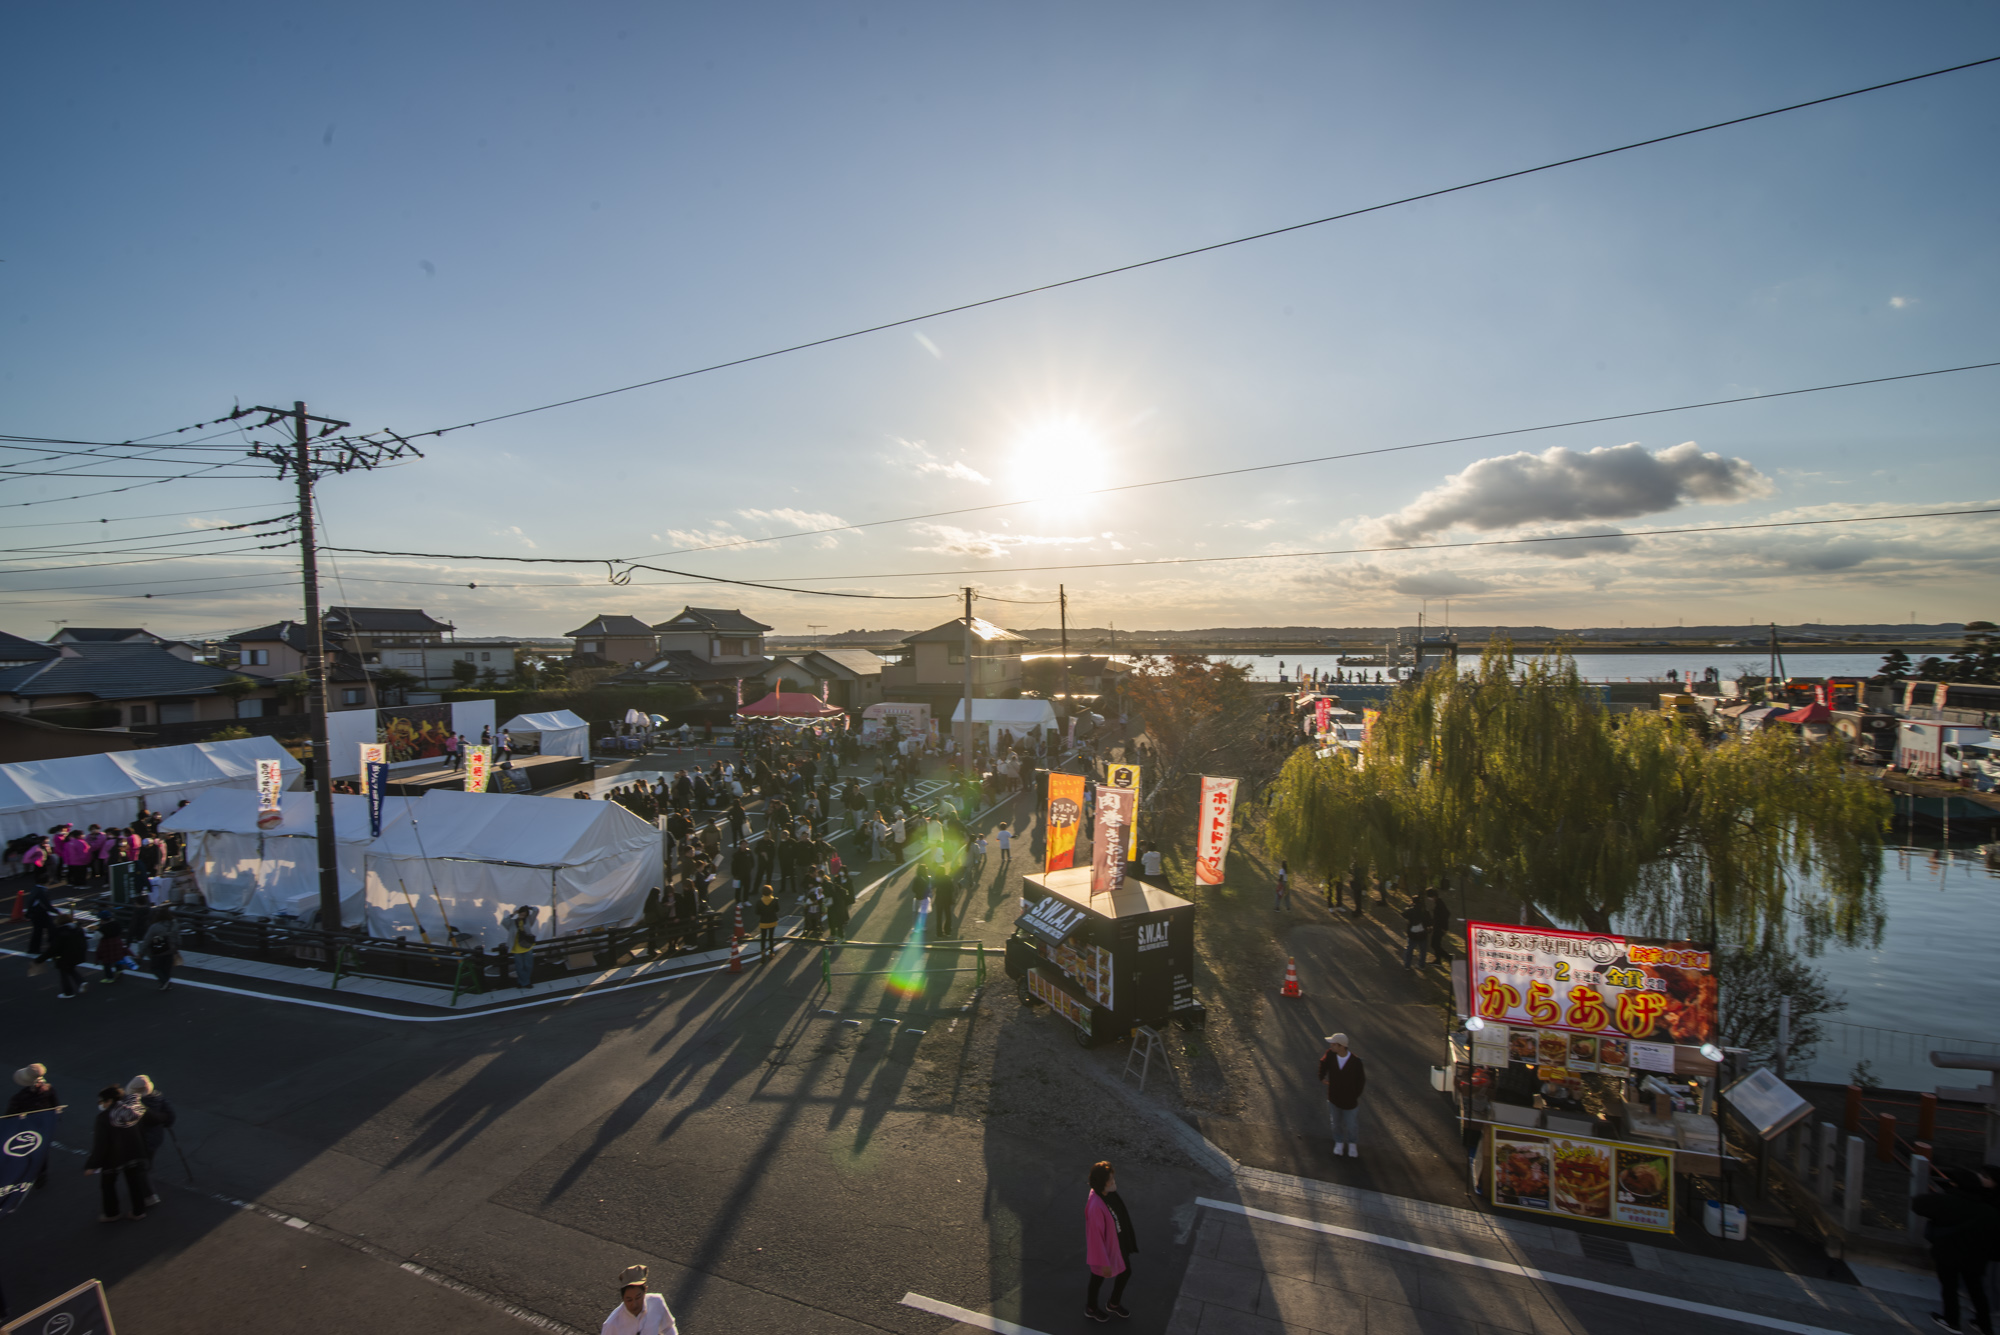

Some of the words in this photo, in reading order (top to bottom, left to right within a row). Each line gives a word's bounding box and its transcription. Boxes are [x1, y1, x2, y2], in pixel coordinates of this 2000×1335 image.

[1208, 791, 1228, 869] ホットドッグ
[1031, 896, 1087, 932] S.W.A.T
[1137, 920, 1169, 945] S.W.A.T
[1477, 929, 1589, 958] からあげ専門店
[1478, 975, 1668, 1039] からあげ
